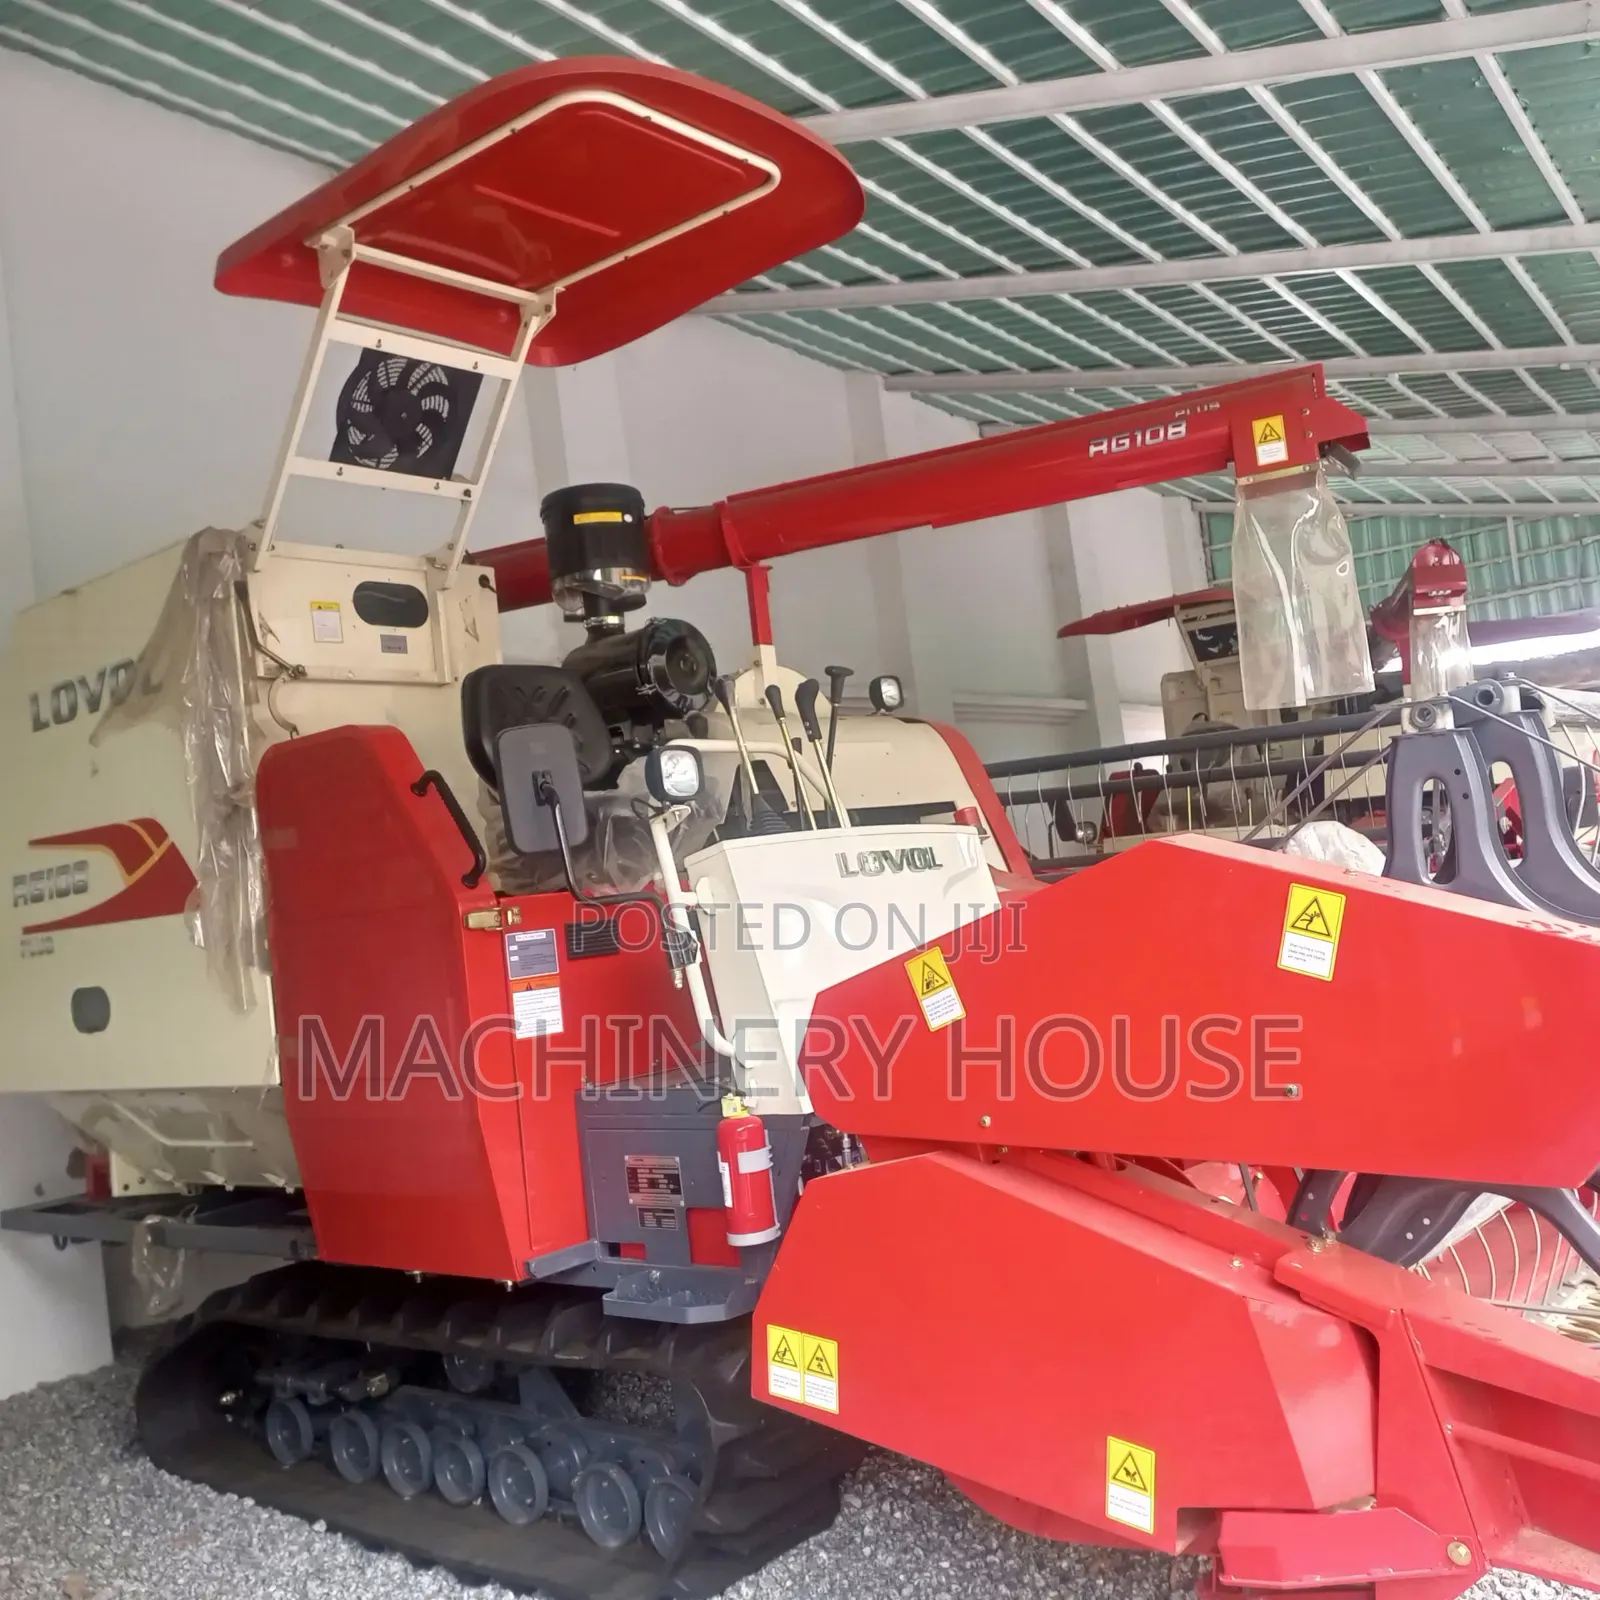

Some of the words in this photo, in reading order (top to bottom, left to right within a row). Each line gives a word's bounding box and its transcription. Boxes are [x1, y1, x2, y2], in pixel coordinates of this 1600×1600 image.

[1088, 419, 1187, 458] RG108
[29, 655, 164, 733] LOVOL
[834, 846, 943, 878] LOVOL
